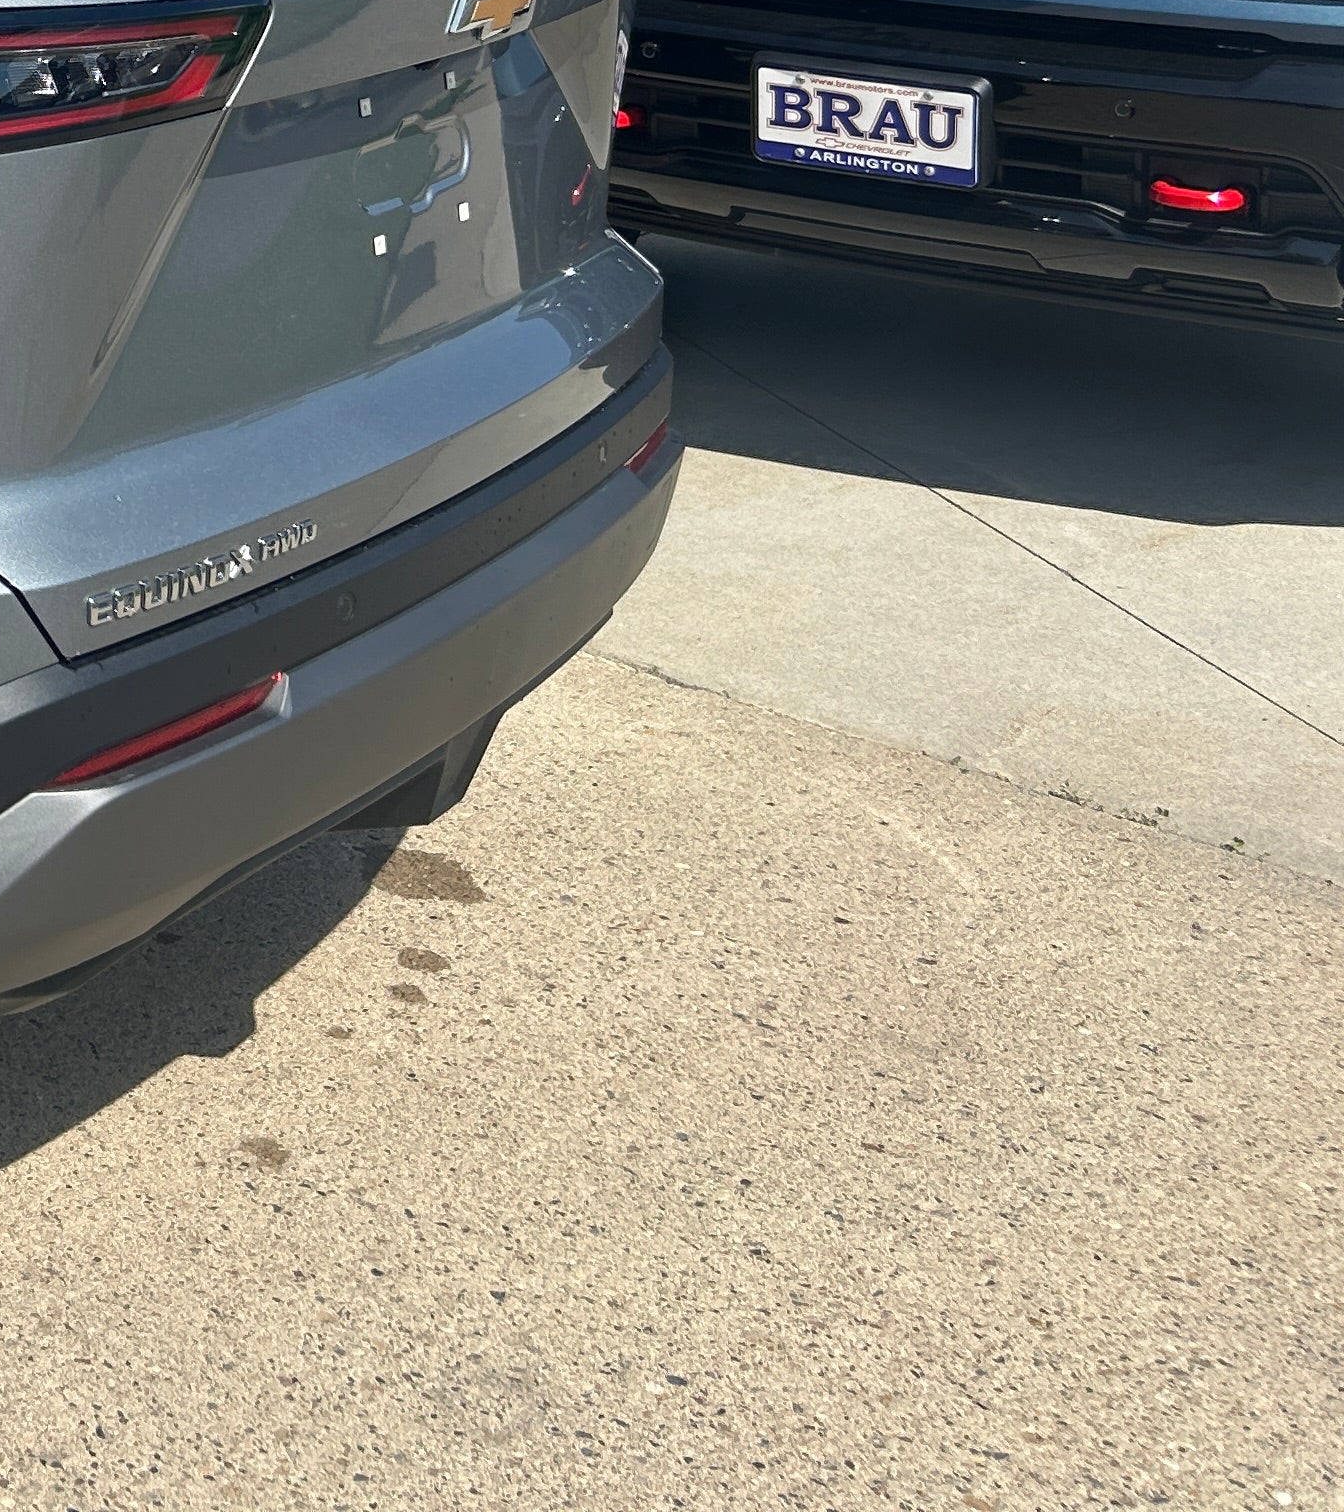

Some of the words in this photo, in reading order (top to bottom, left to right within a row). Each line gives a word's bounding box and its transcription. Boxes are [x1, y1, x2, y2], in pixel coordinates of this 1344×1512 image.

[809, 76, 919, 97] www.braumotors.com
[766, 82, 964, 151] BRAU
[809, 149, 919, 175] ARLINGTON
[844, 141, 912, 157] CHEVROLET
[258, 518, 318, 561] AWD
[86, 544, 254, 627] EQUINOX
